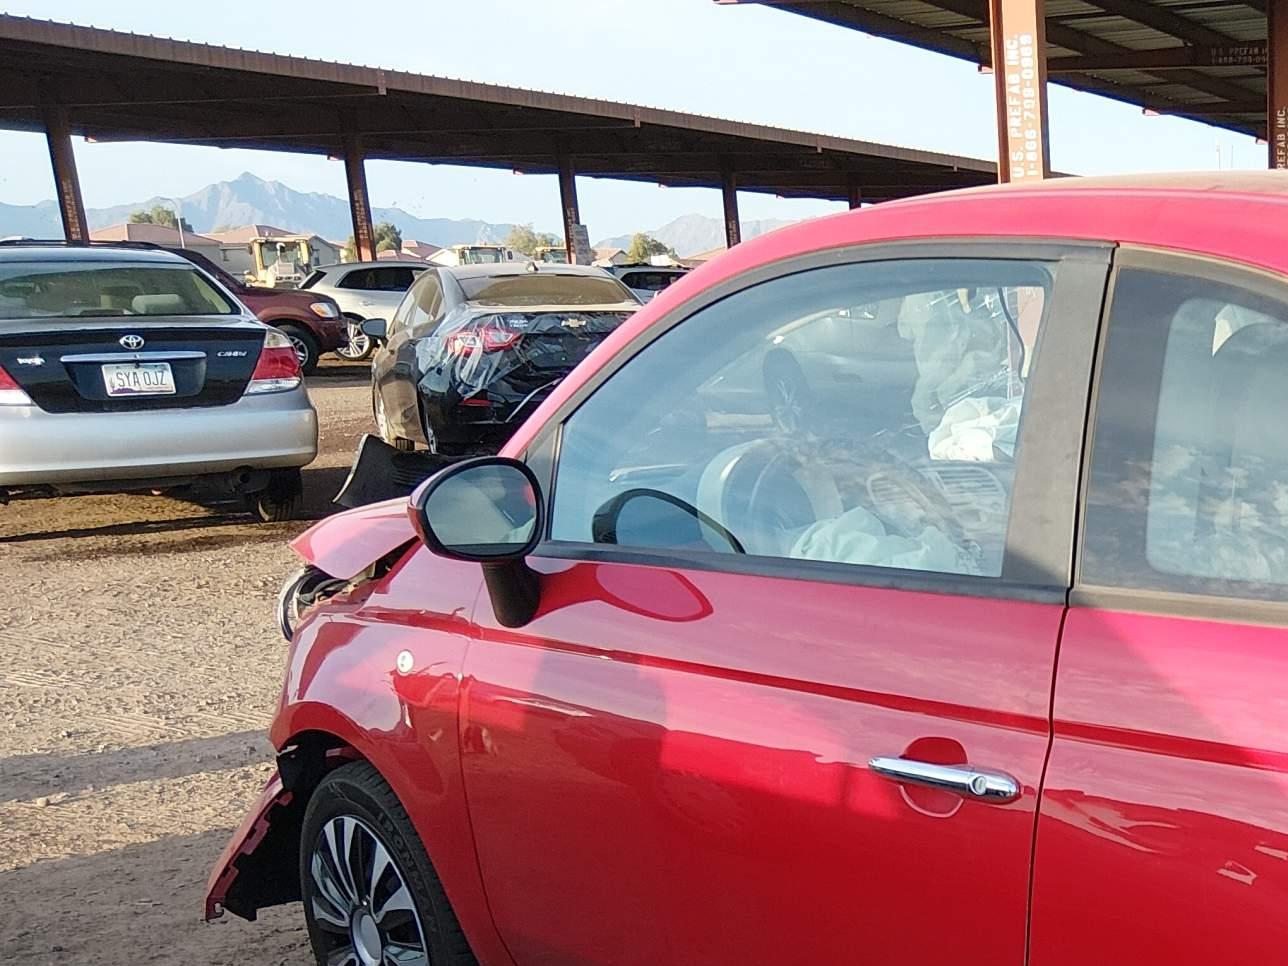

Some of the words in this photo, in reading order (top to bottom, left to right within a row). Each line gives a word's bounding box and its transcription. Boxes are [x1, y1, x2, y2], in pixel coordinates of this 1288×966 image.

[1006, 34, 1020, 66] INC.
[1007, 73, 1023, 138] PREFAB
[1012, 145, 1025, 179] U.S.
[1276, 134, 1286, 170] REFAB
[116, 371, 141, 387] SYA
